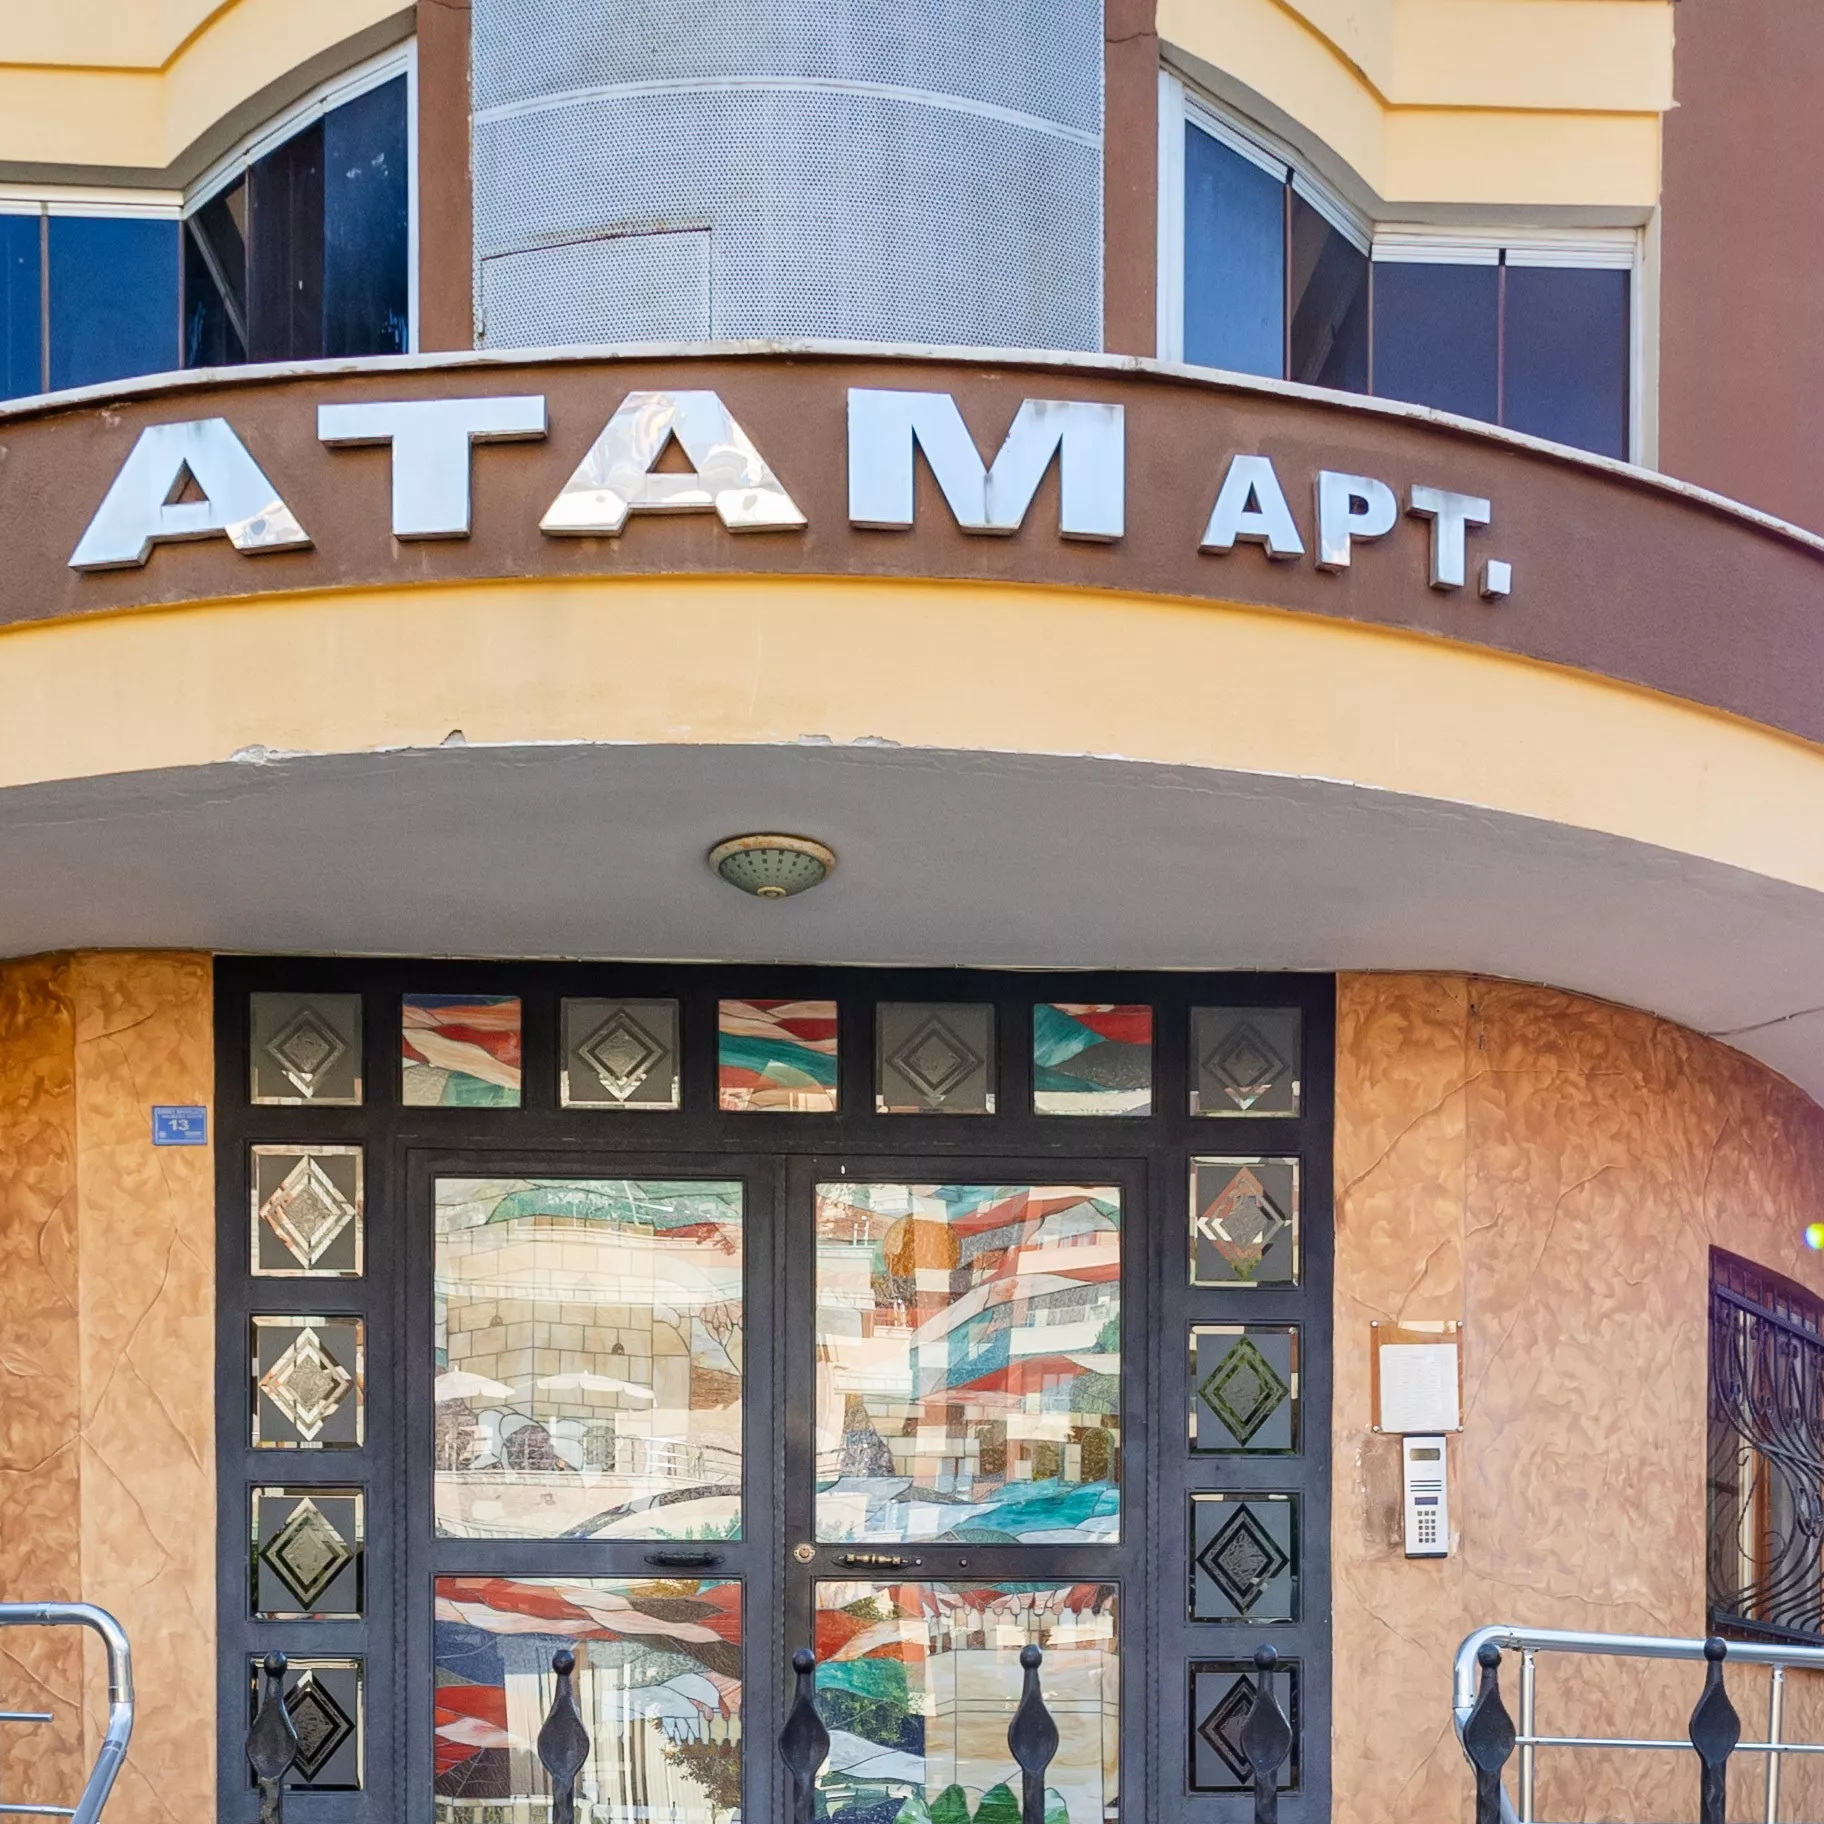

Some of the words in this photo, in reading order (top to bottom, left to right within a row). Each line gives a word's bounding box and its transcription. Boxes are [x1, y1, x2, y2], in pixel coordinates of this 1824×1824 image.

[68, 386, 1125, 573] ATAM
[1198, 454, 1513, 598] APT.
[168, 1119, 190, 1131] 13
